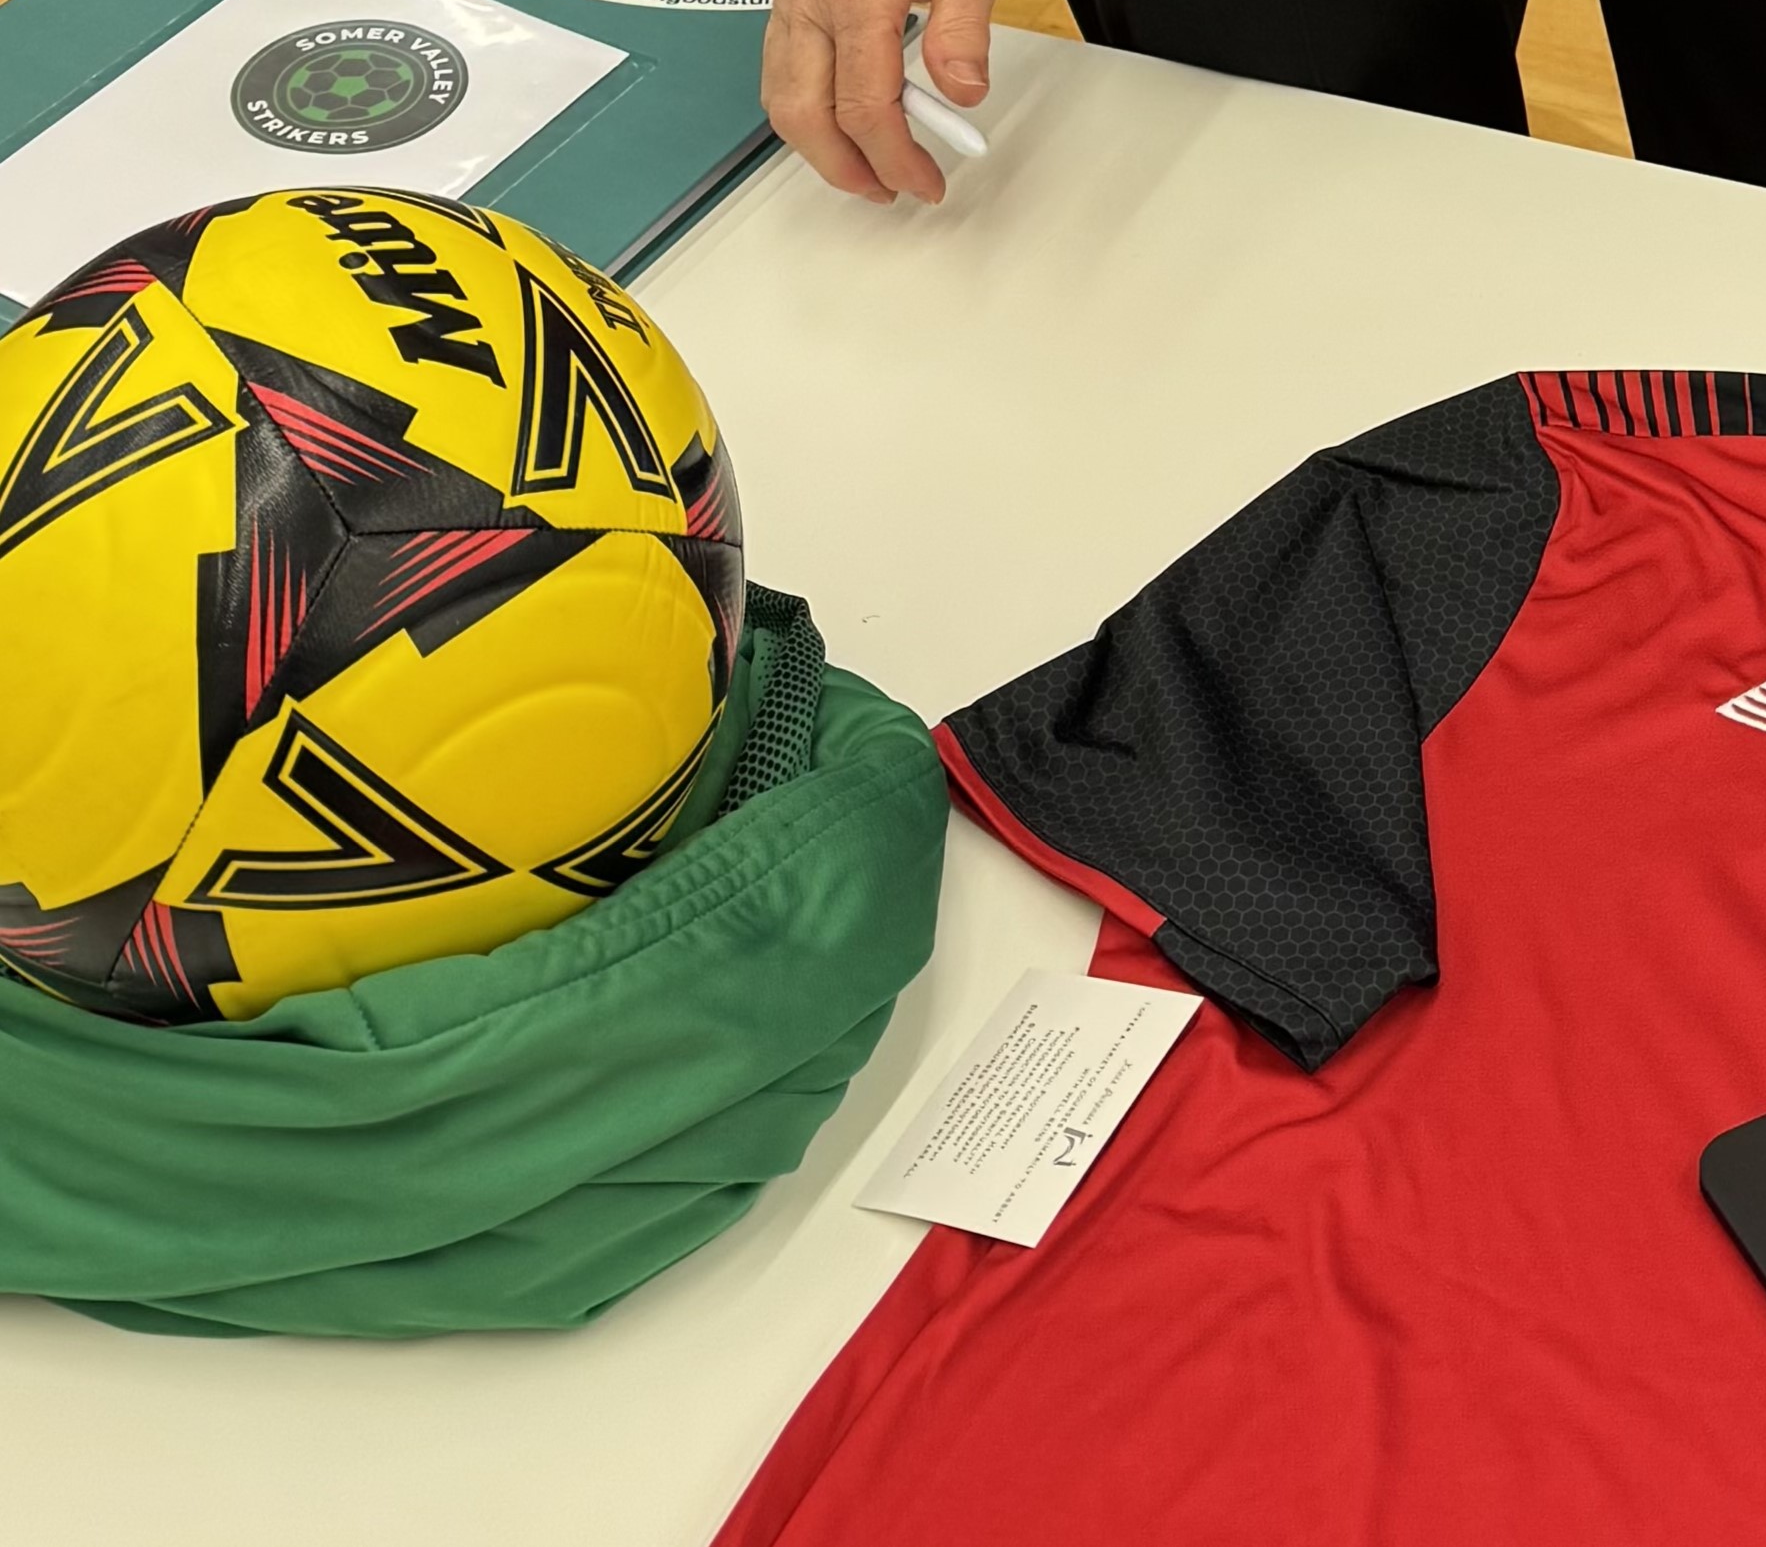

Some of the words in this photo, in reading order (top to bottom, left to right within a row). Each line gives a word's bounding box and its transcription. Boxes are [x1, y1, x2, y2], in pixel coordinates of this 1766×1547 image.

[295, 25, 406, 54] SOMER
[409, 34, 454, 107] VALLEY
[245, 98, 370, 147] STRIKERS
[285, 192, 508, 391] Mitre
[1071, 1066, 1090, 1089] WITH
[1094, 1040, 1121, 1075] VARIETY
[1053, 1090, 1073, 1115] WELL
[1056, 1088, 1087, 1129] COURSES
[1023, 1129, 1058, 1175] PRIMARILY
[990, 1191, 1016, 1223] ASSIST
